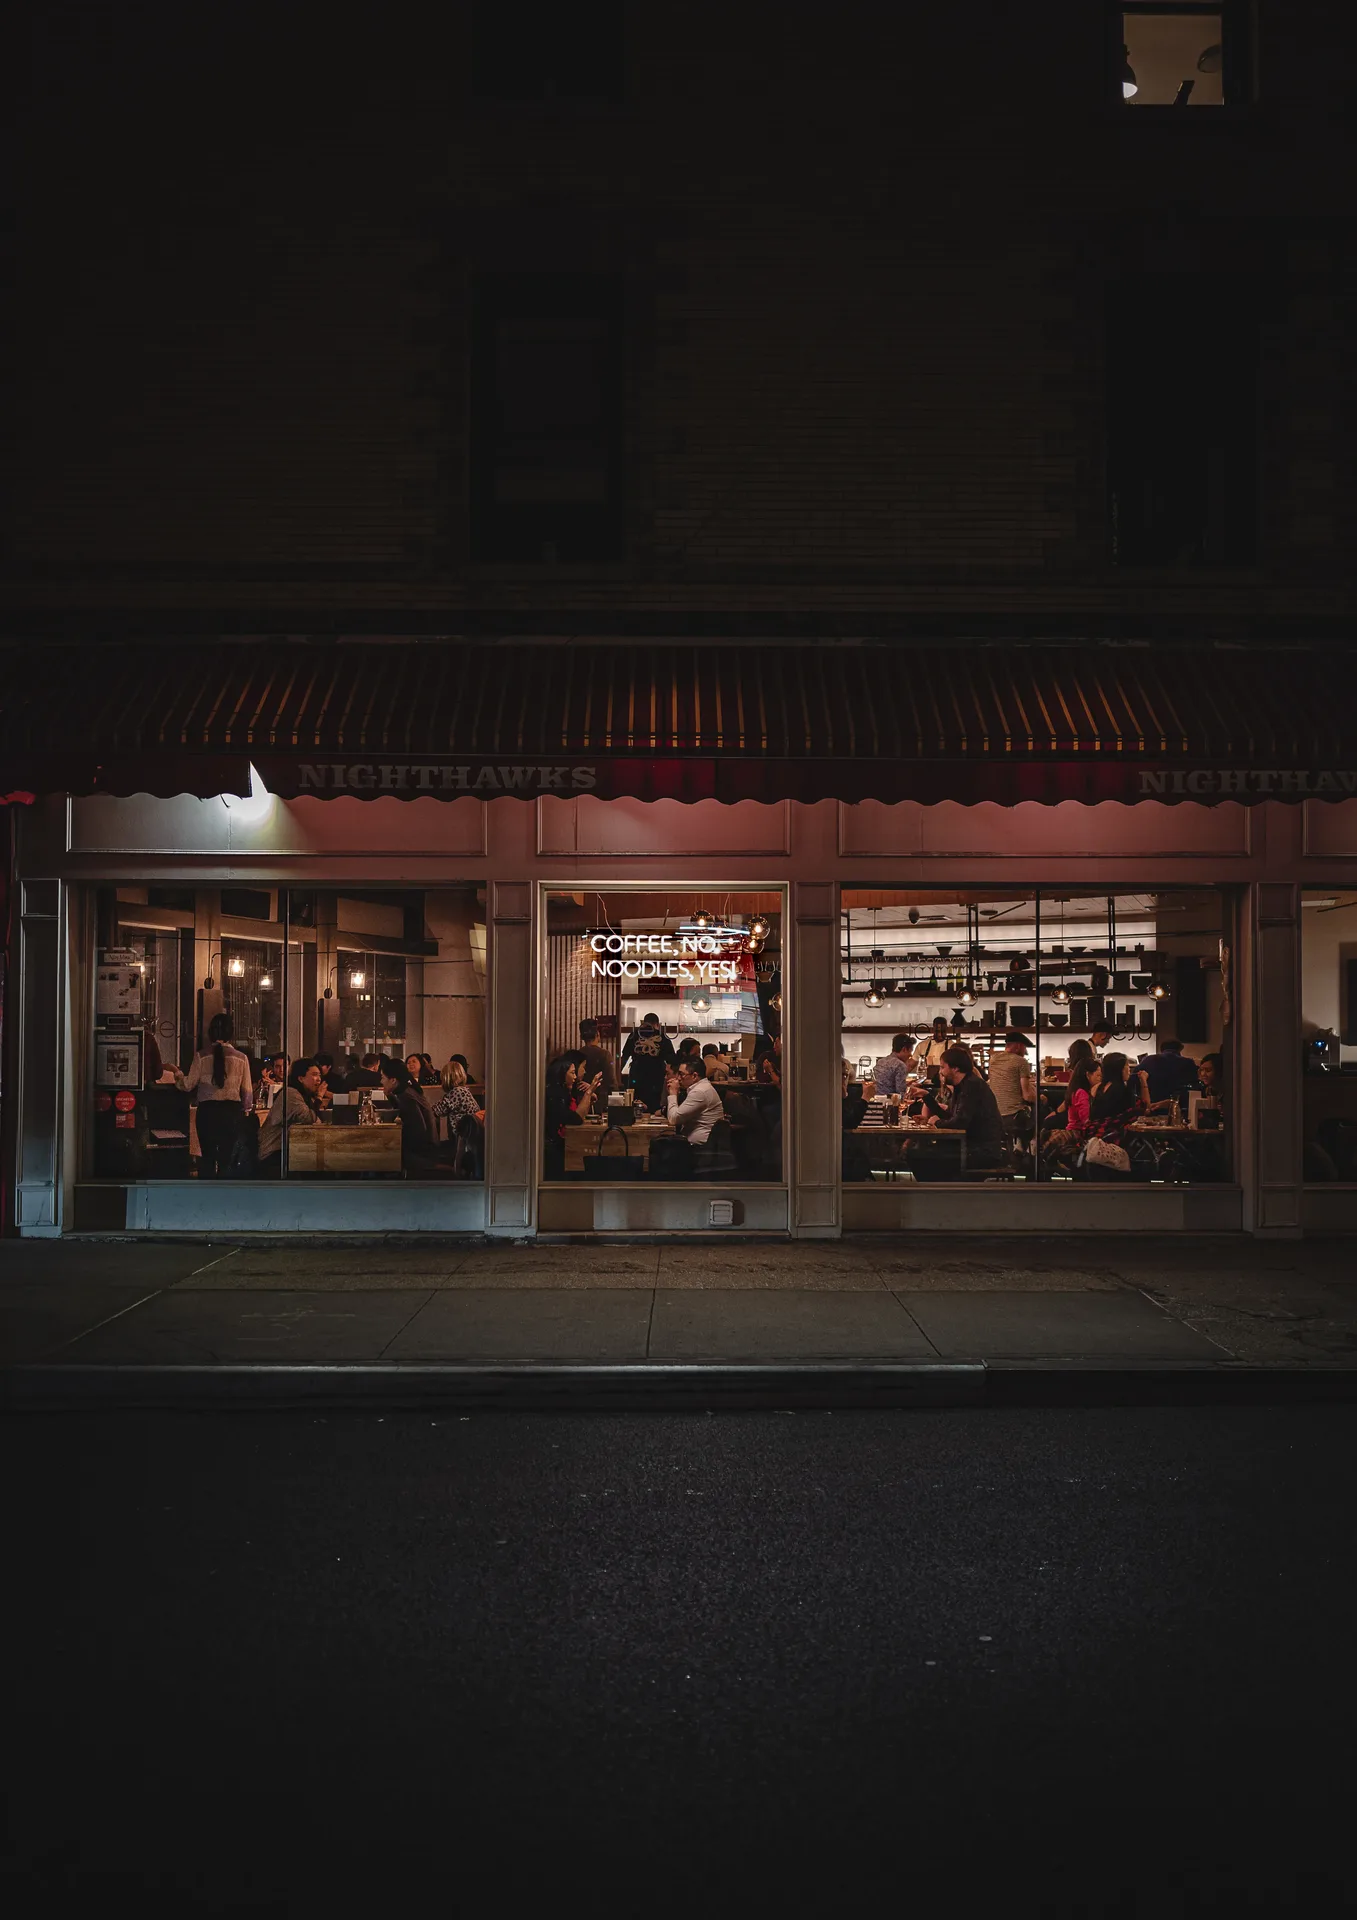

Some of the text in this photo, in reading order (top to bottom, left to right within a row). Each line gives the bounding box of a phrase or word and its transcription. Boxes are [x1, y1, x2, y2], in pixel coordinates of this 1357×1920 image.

[297, 763, 597, 789] NIGHTHAWKS
[590, 934, 679, 957] COFFEE,
[591, 959, 738, 981] NOODLES, YES!
